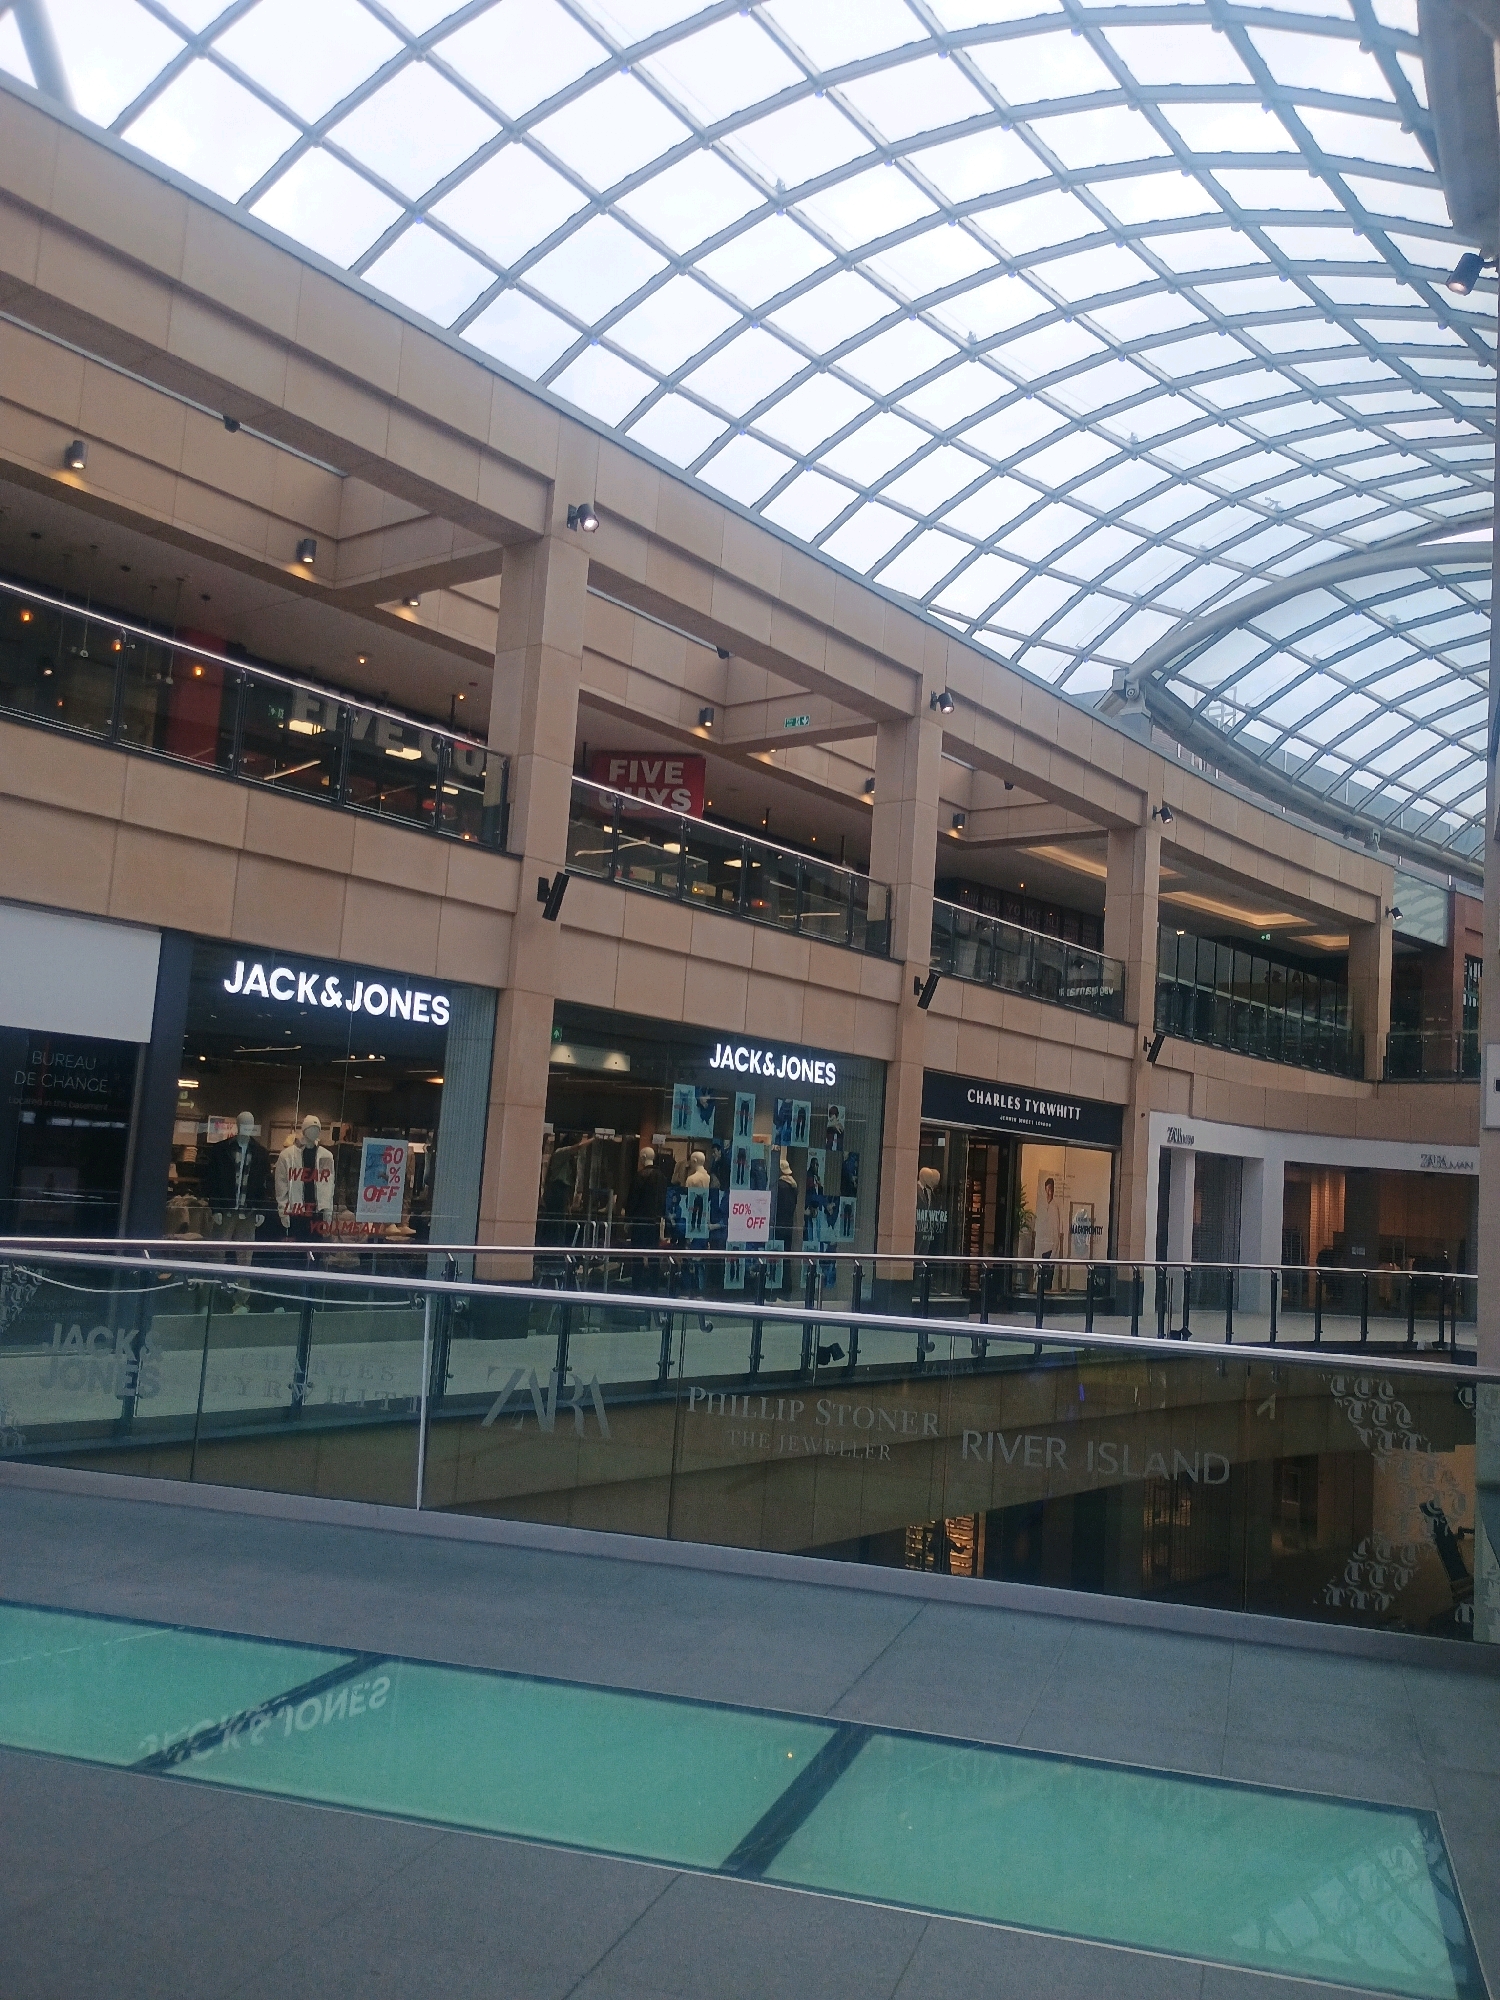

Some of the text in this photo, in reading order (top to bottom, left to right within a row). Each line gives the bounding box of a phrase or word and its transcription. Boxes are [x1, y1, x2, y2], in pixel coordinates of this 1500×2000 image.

[608, 758, 684, 785] FIVE
[598, 785, 692, 813] GUYS
[223, 959, 451, 1026] JACK&JONES
[31, 1050, 97, 1070] BUREAU
[709, 1042, 837, 1087] JACK&JONES
[14, 1070, 109, 1093] DE CHANGE
[966, 1088, 1081, 1121] CHARLES TYRWHITT
[288, 1167, 331, 1183] WEAR
[388, 1166, 401, 1184] %
[363, 1185, 401, 1203] OFF
[283, 1202, 316, 1217] LIKE
[732, 1203, 752, 1216] 50%
[746, 1216, 767, 1229] OFF
[38, 1358, 162, 1399] JONES
[481, 1365, 612, 1440] ZARA
[686, 1385, 940, 1437] PHILLIP STONER
[728, 1428, 892, 1462] THE JEWELLER
[961, 1429, 1231, 1486] RIVER ISLAND
